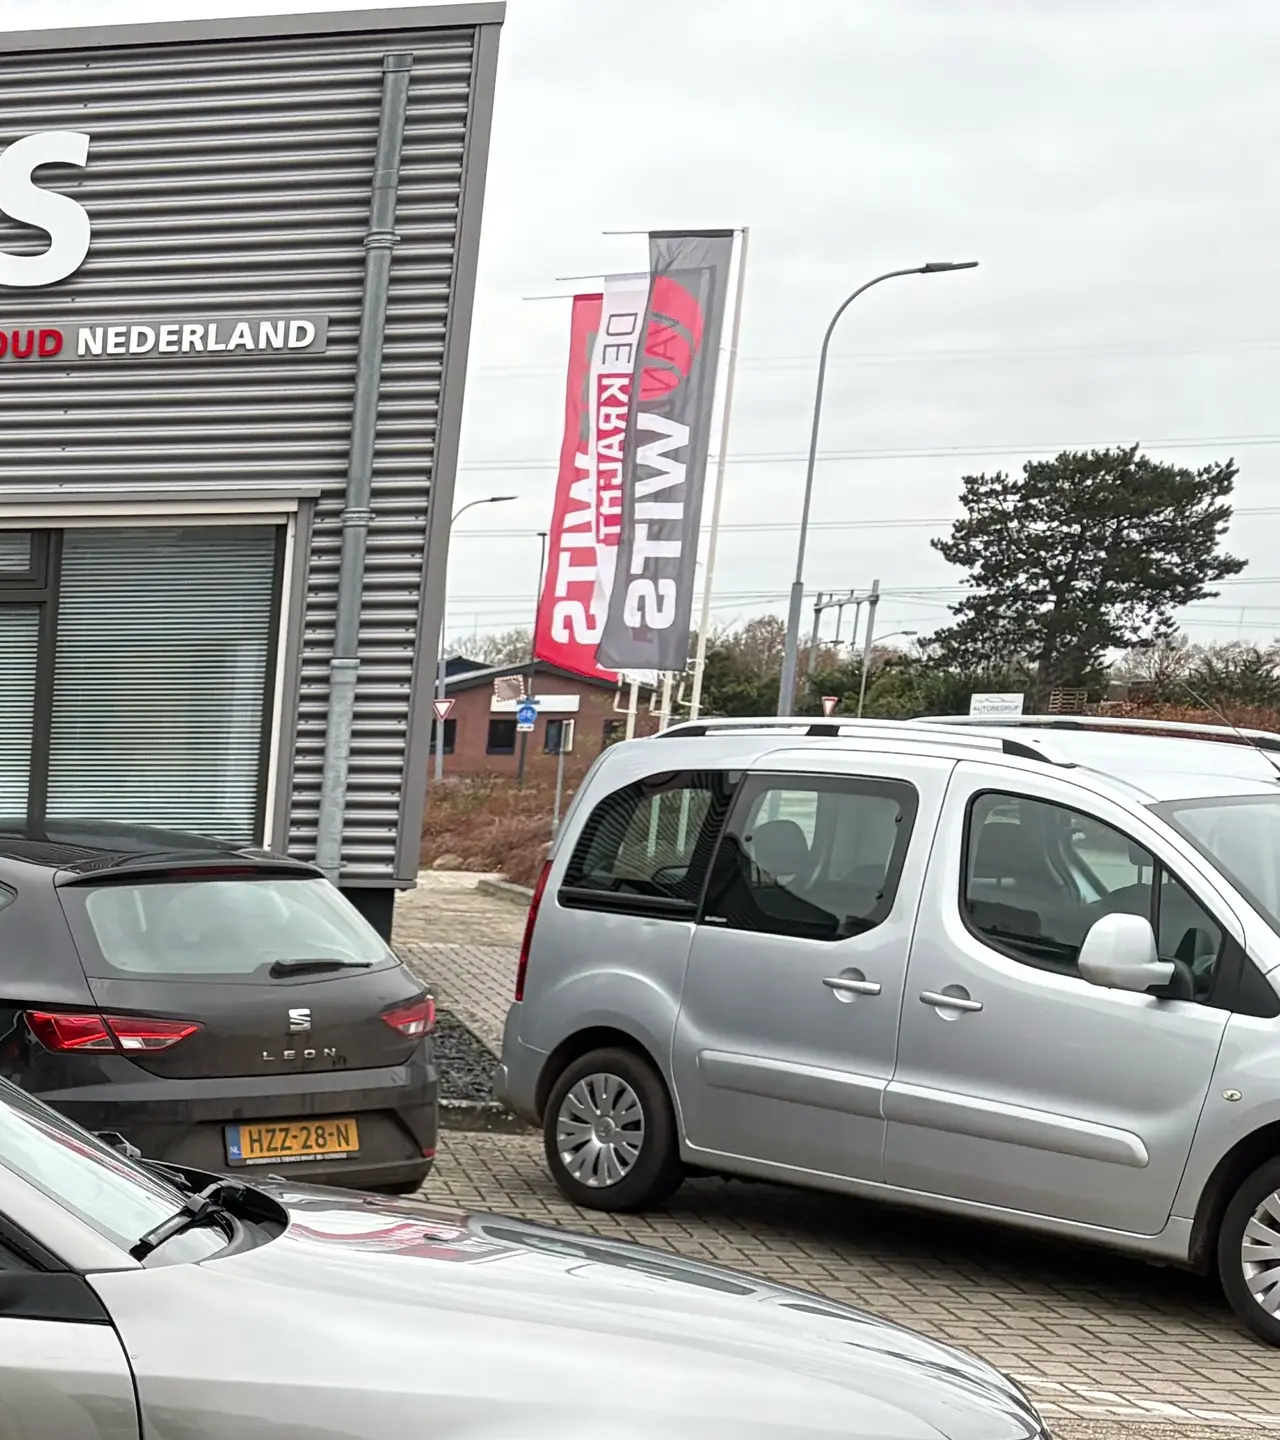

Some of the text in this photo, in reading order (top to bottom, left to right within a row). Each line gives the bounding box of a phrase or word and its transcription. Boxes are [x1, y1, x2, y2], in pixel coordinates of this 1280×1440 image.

[77, 320, 316, 355] NEDERLAND
[262, 1047, 337, 1061] LEON
[248, 1123, 351, 1154] HZZ-28-N
